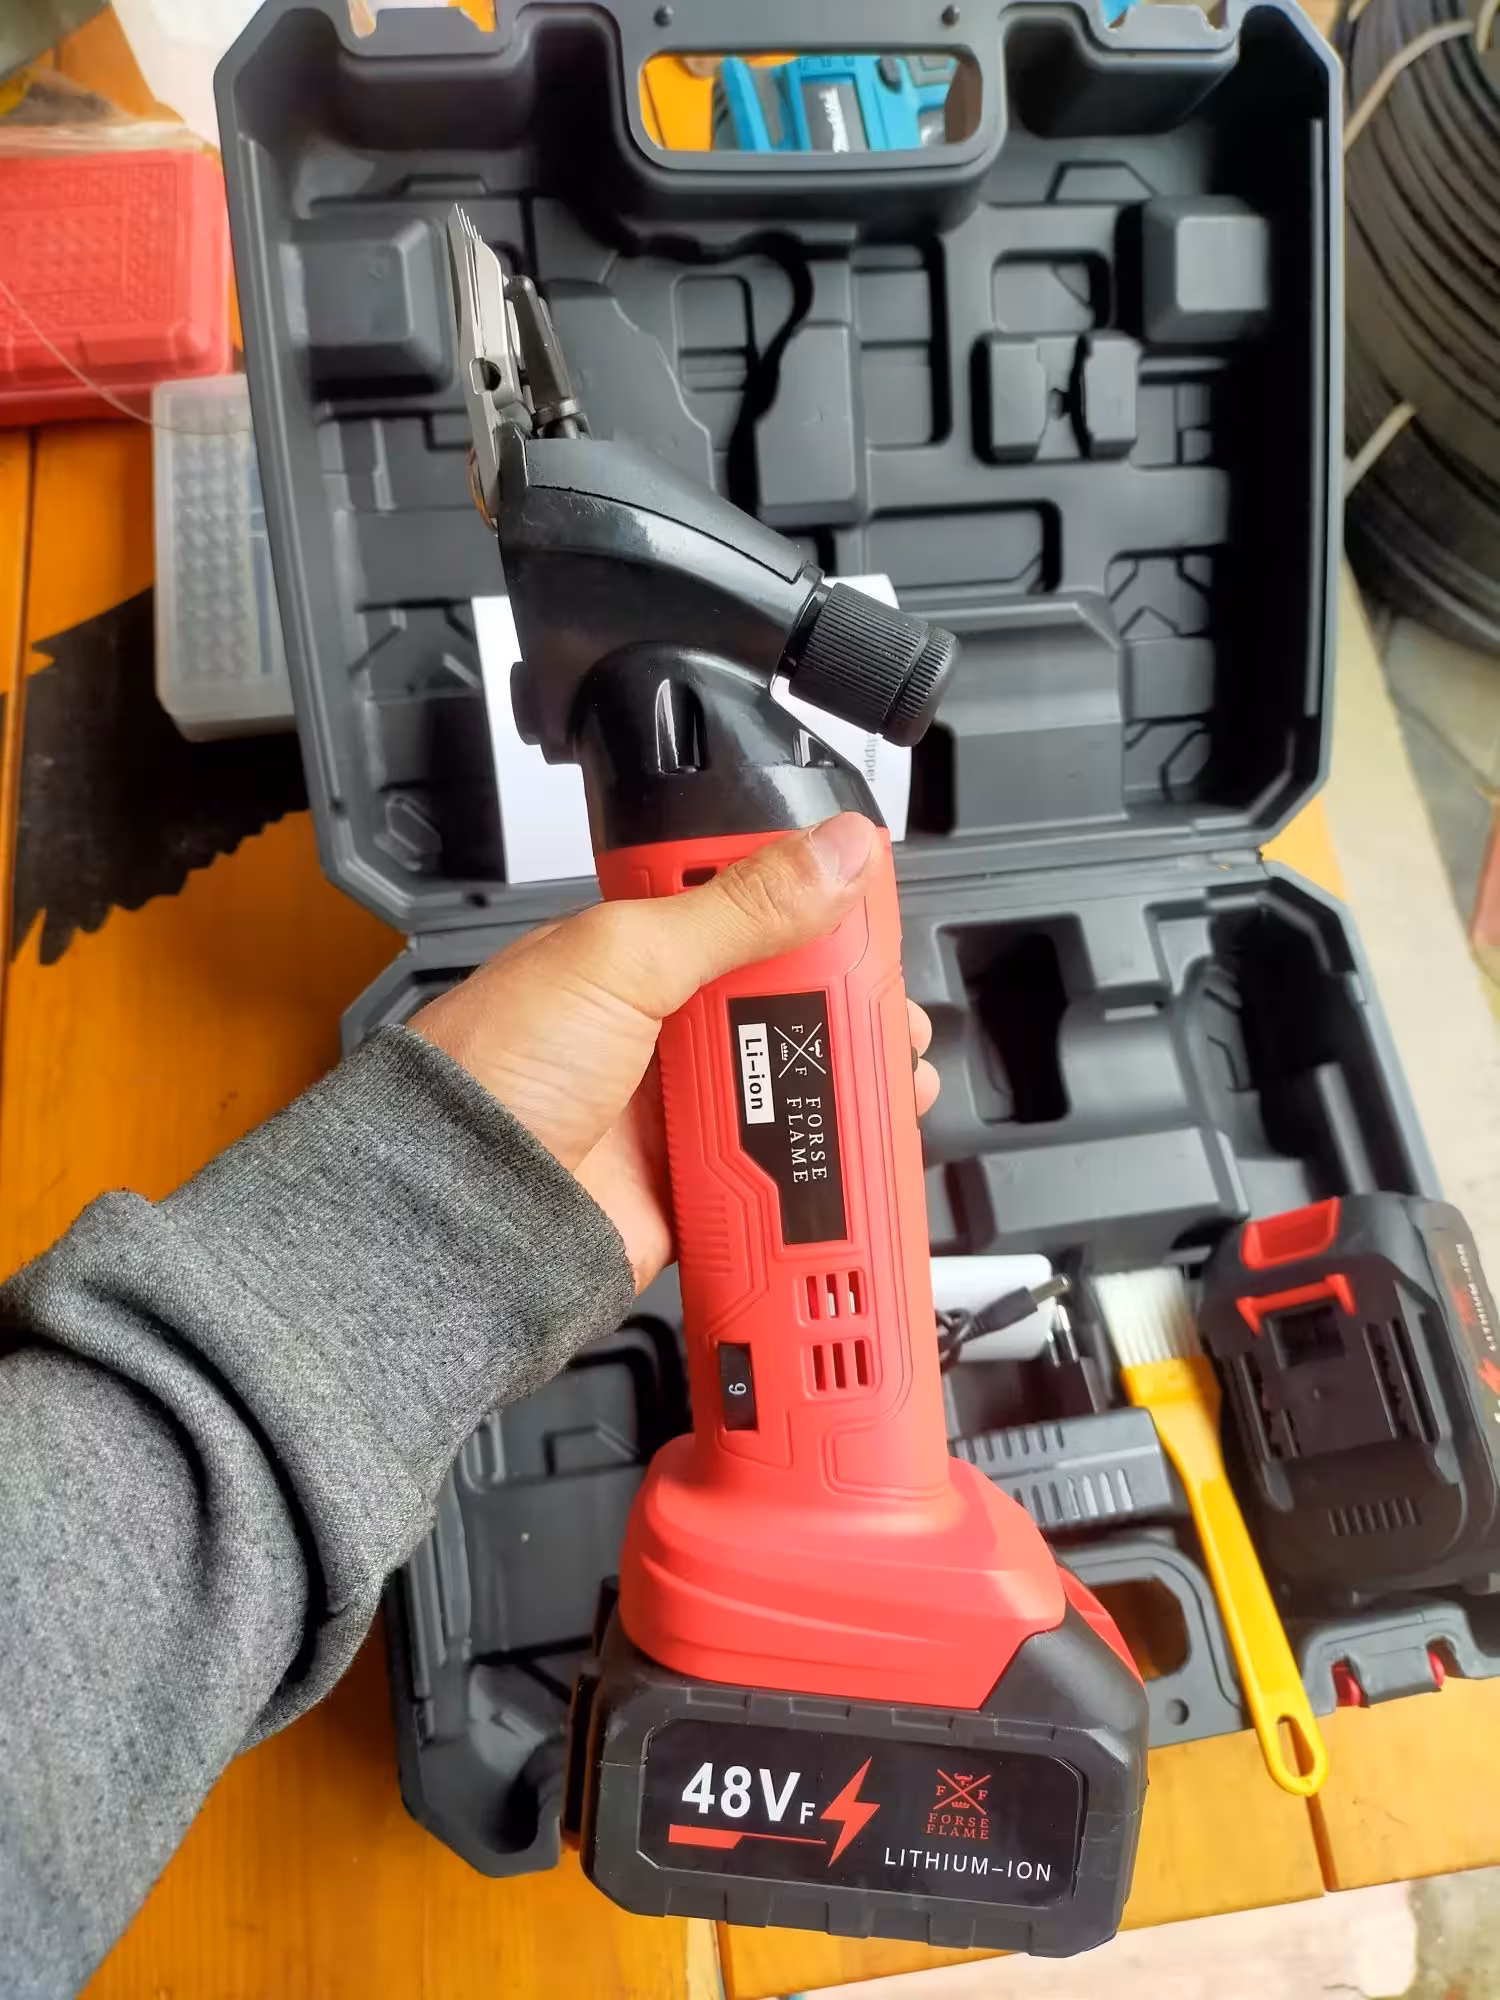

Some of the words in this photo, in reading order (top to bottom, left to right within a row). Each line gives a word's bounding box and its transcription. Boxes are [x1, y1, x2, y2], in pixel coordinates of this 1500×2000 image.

[745, 1038, 765, 1110] Li-ion
[786, 1096, 809, 1183] FLAME
[805, 1097, 828, 1180] FORSE
[925, 1823, 989, 1840] FLAME
[928, 1812, 990, 1829] FORSE
[884, 1847, 1051, 1882] LITHIUM-ION
